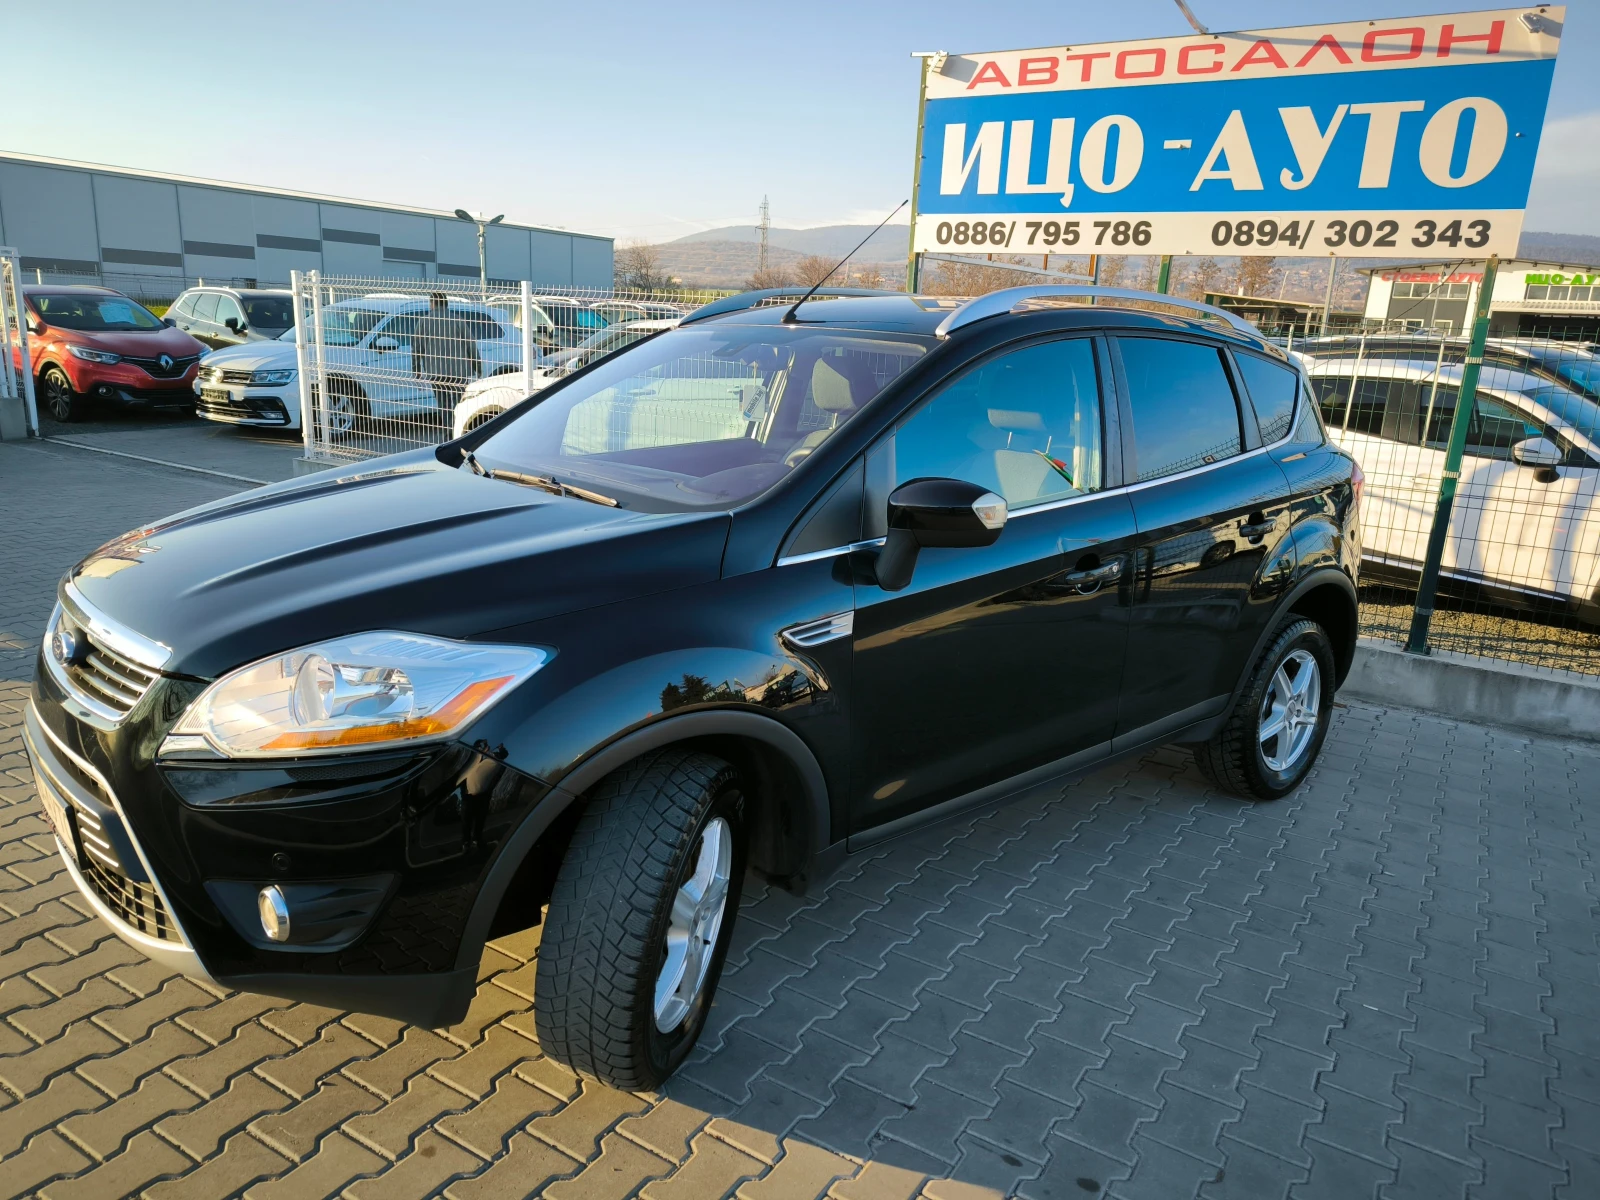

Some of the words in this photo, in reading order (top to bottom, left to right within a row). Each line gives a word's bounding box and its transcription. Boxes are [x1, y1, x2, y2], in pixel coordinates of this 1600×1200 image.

[966, 19, 1506, 90] АВТОСАЛОН
[935, 220, 1016, 248] 0886/
[1025, 220, 1081, 246] 795
[1092, 220, 1153, 247] 786
[1210, 218, 1315, 249] 0894/
[1323, 218, 1399, 248] 302
[1410, 218, 1492, 249] 343
[1525, 273, 1600, 285] ИЦО-АУ
